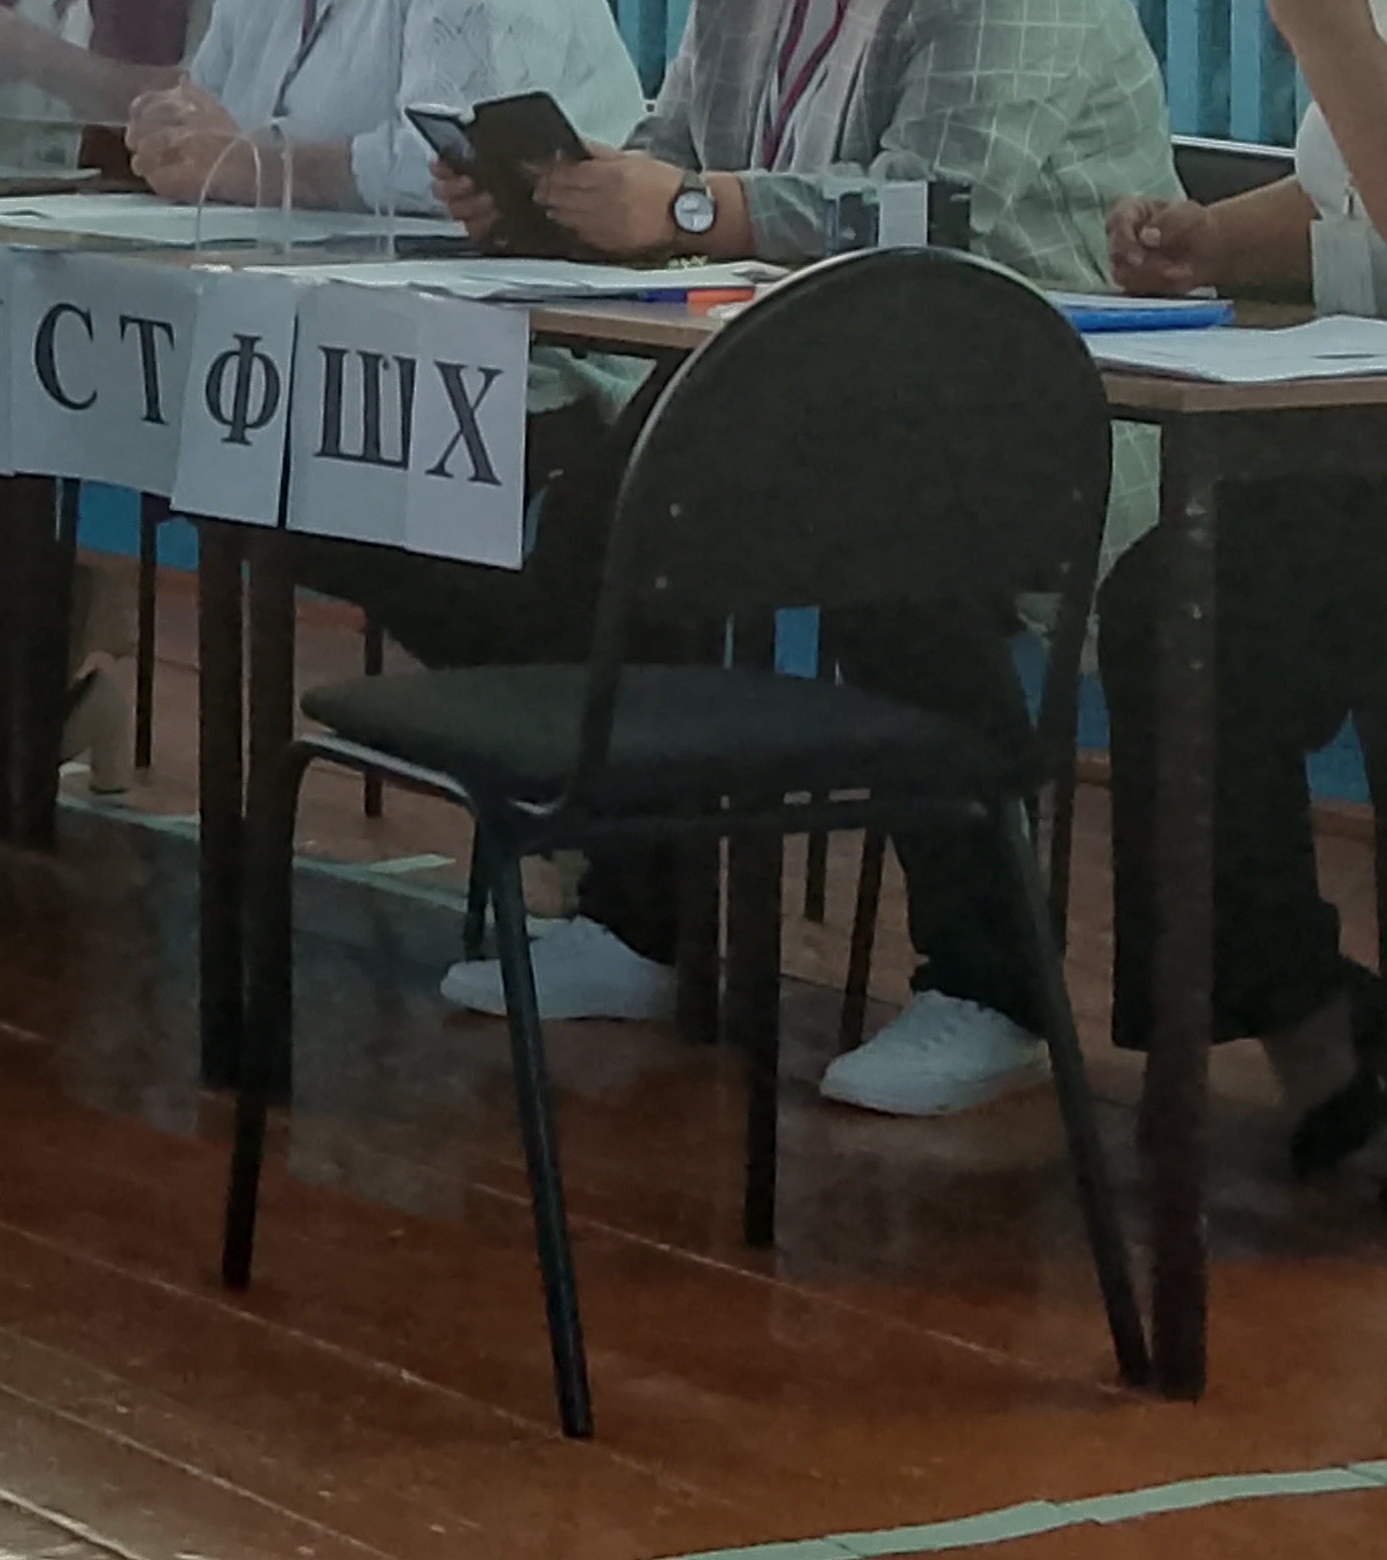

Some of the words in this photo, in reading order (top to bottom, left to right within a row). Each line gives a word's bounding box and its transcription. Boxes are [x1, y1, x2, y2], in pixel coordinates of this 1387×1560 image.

[34, 302, 97, 410] С
[119, 314, 175, 425] Т
[205, 333, 280, 446] Ф
[425, 360, 504, 486] Х
